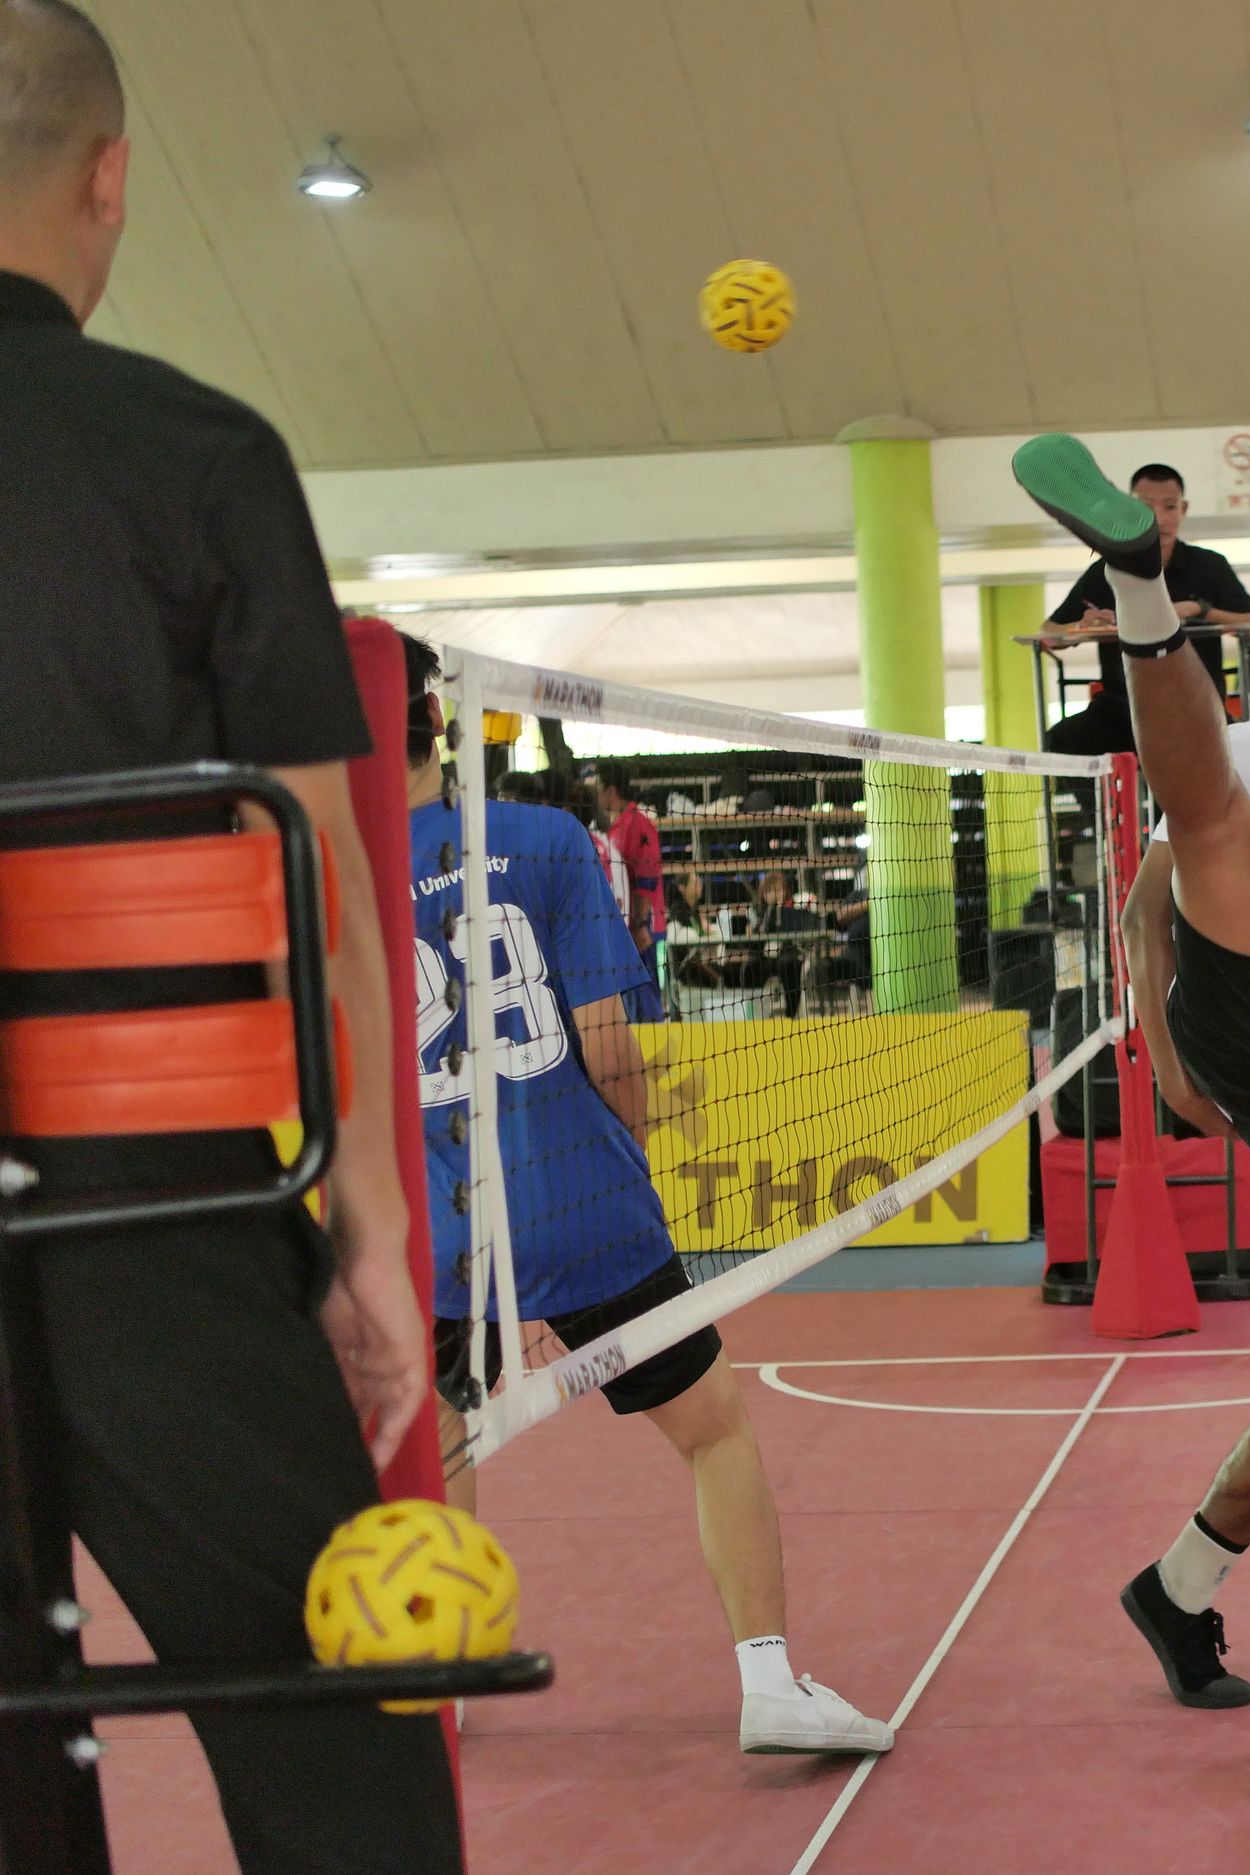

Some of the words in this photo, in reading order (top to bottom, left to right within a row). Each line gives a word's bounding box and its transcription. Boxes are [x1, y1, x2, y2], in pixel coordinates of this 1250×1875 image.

[419, 855, 510, 897] Univeity
[411, 903, 569, 1109] 23
[665, 1154, 979, 1231] THON
